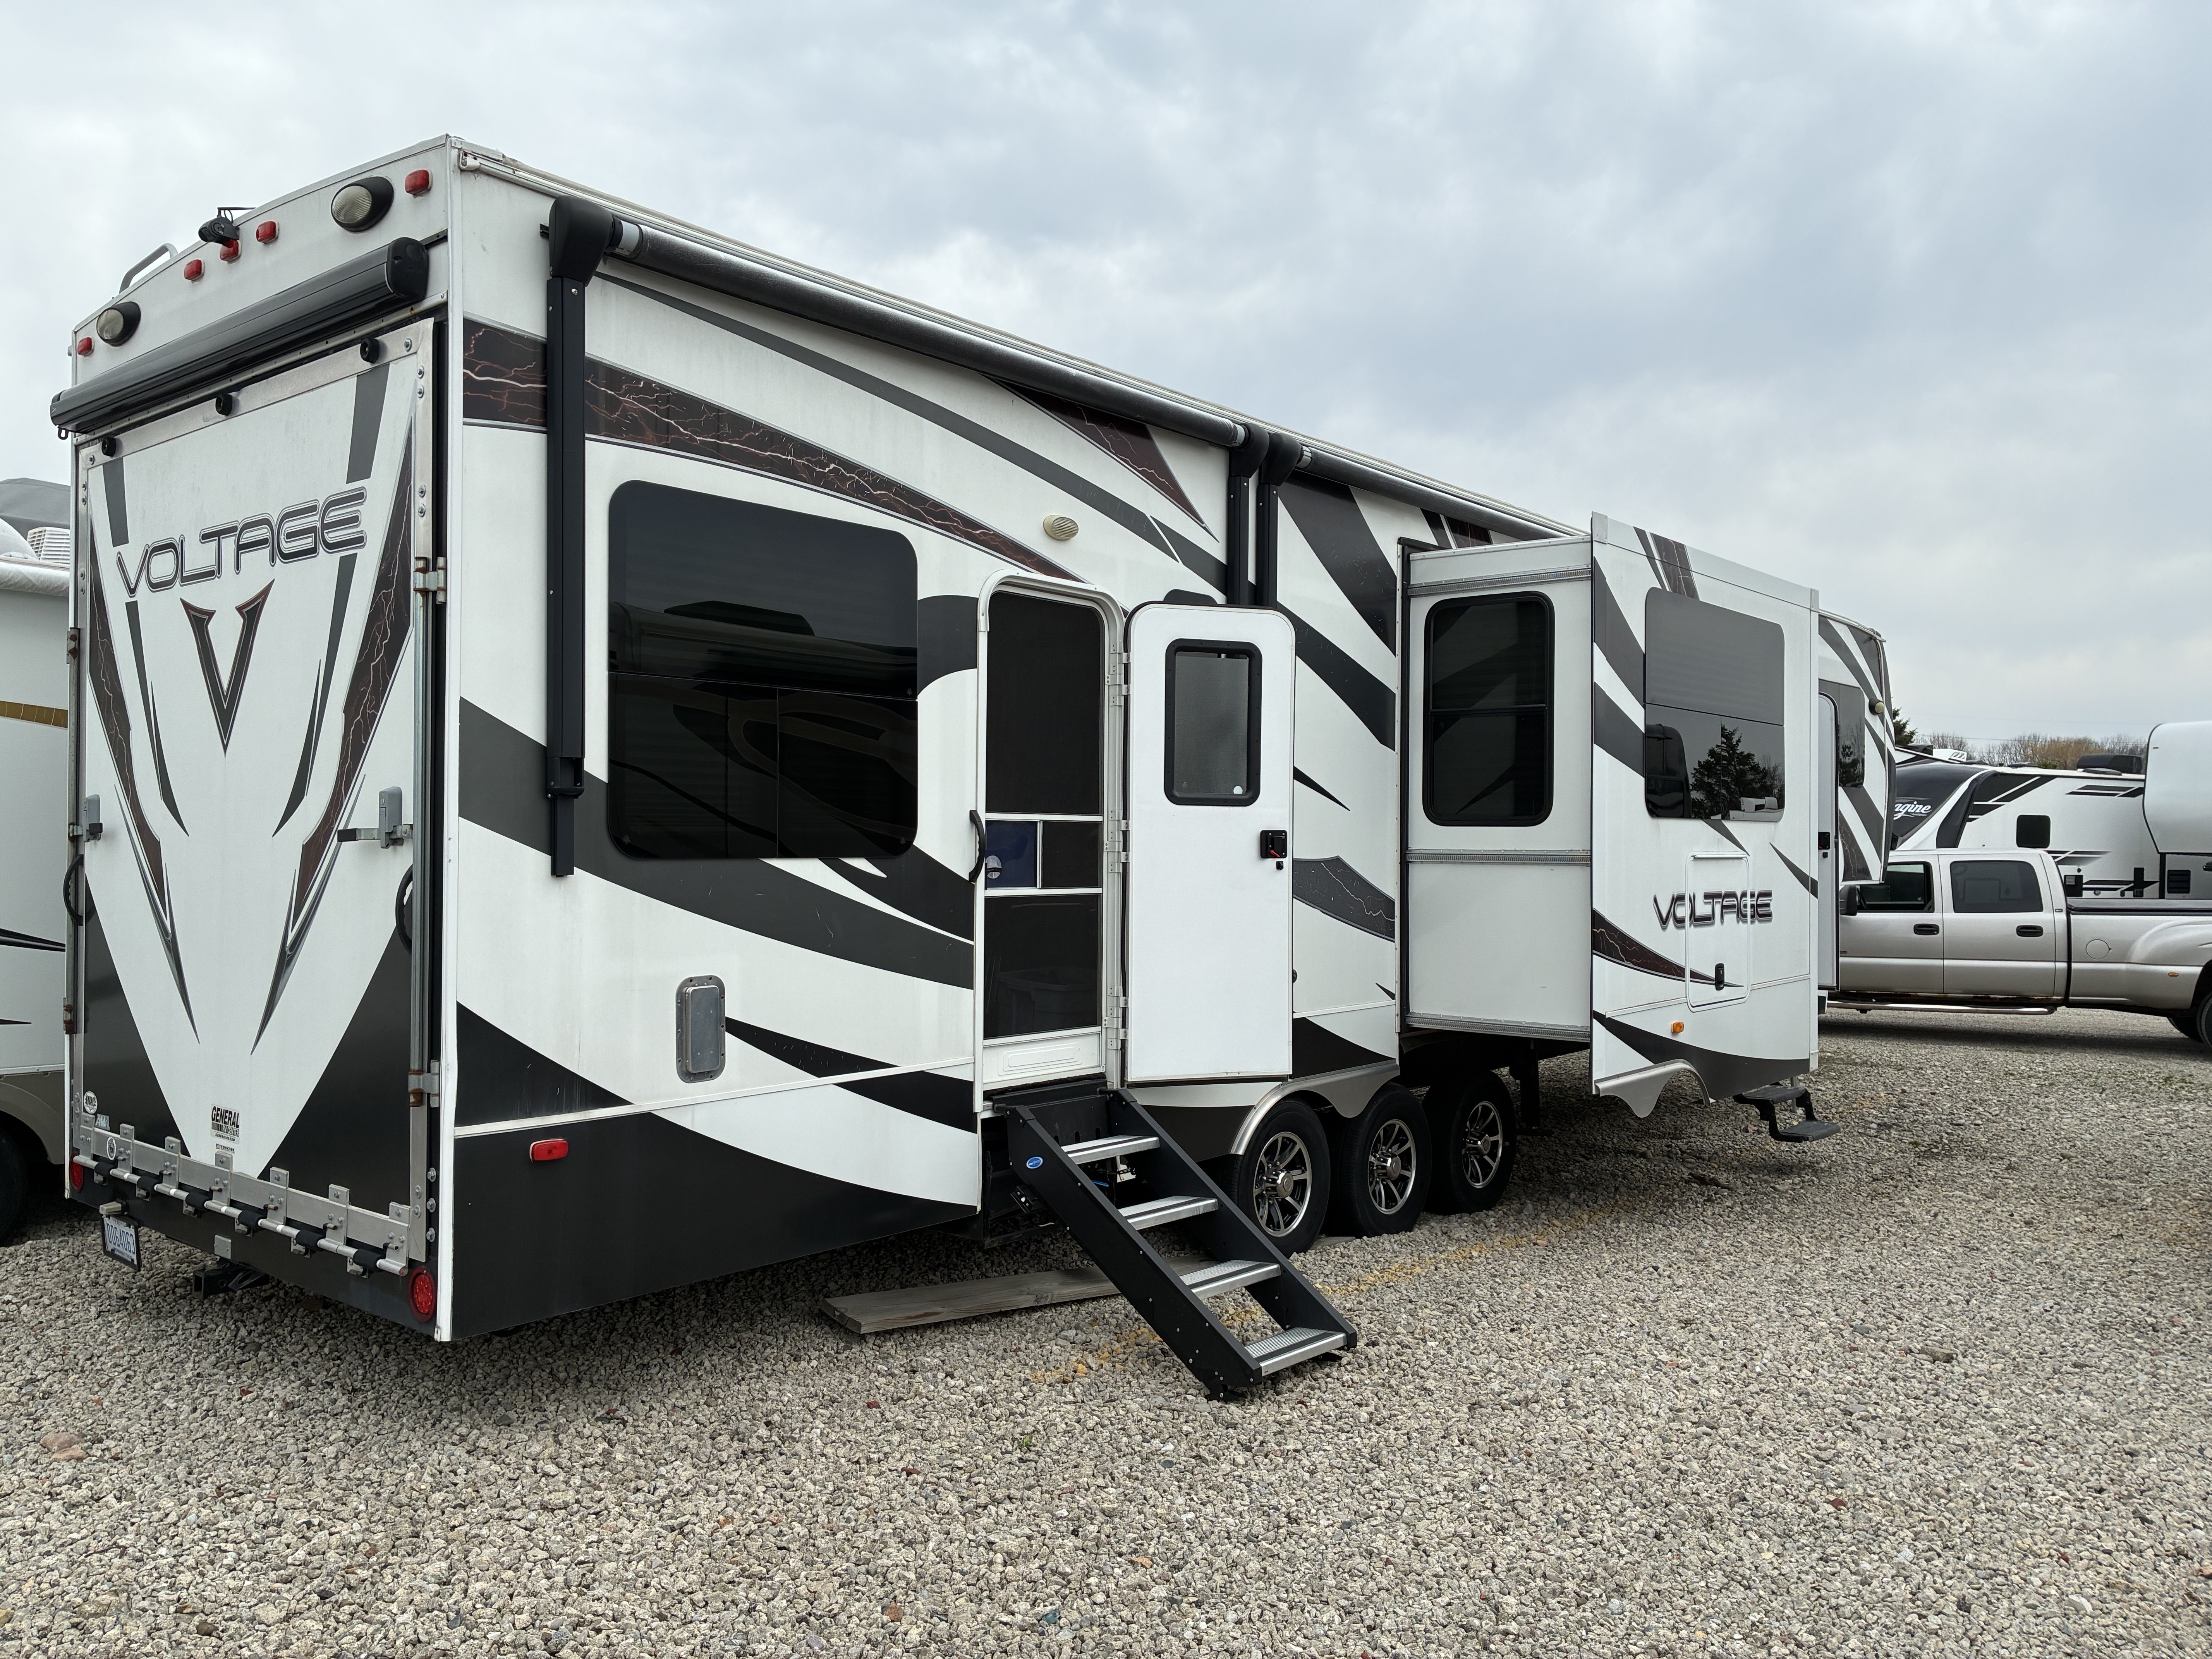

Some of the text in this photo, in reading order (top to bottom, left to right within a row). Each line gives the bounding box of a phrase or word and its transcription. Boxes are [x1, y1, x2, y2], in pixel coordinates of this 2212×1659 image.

[116, 486, 367, 598] VOLTAGE
[1653, 890, 1773, 929] VOLTAGE
[211, 1106, 240, 1128] GENERAL
